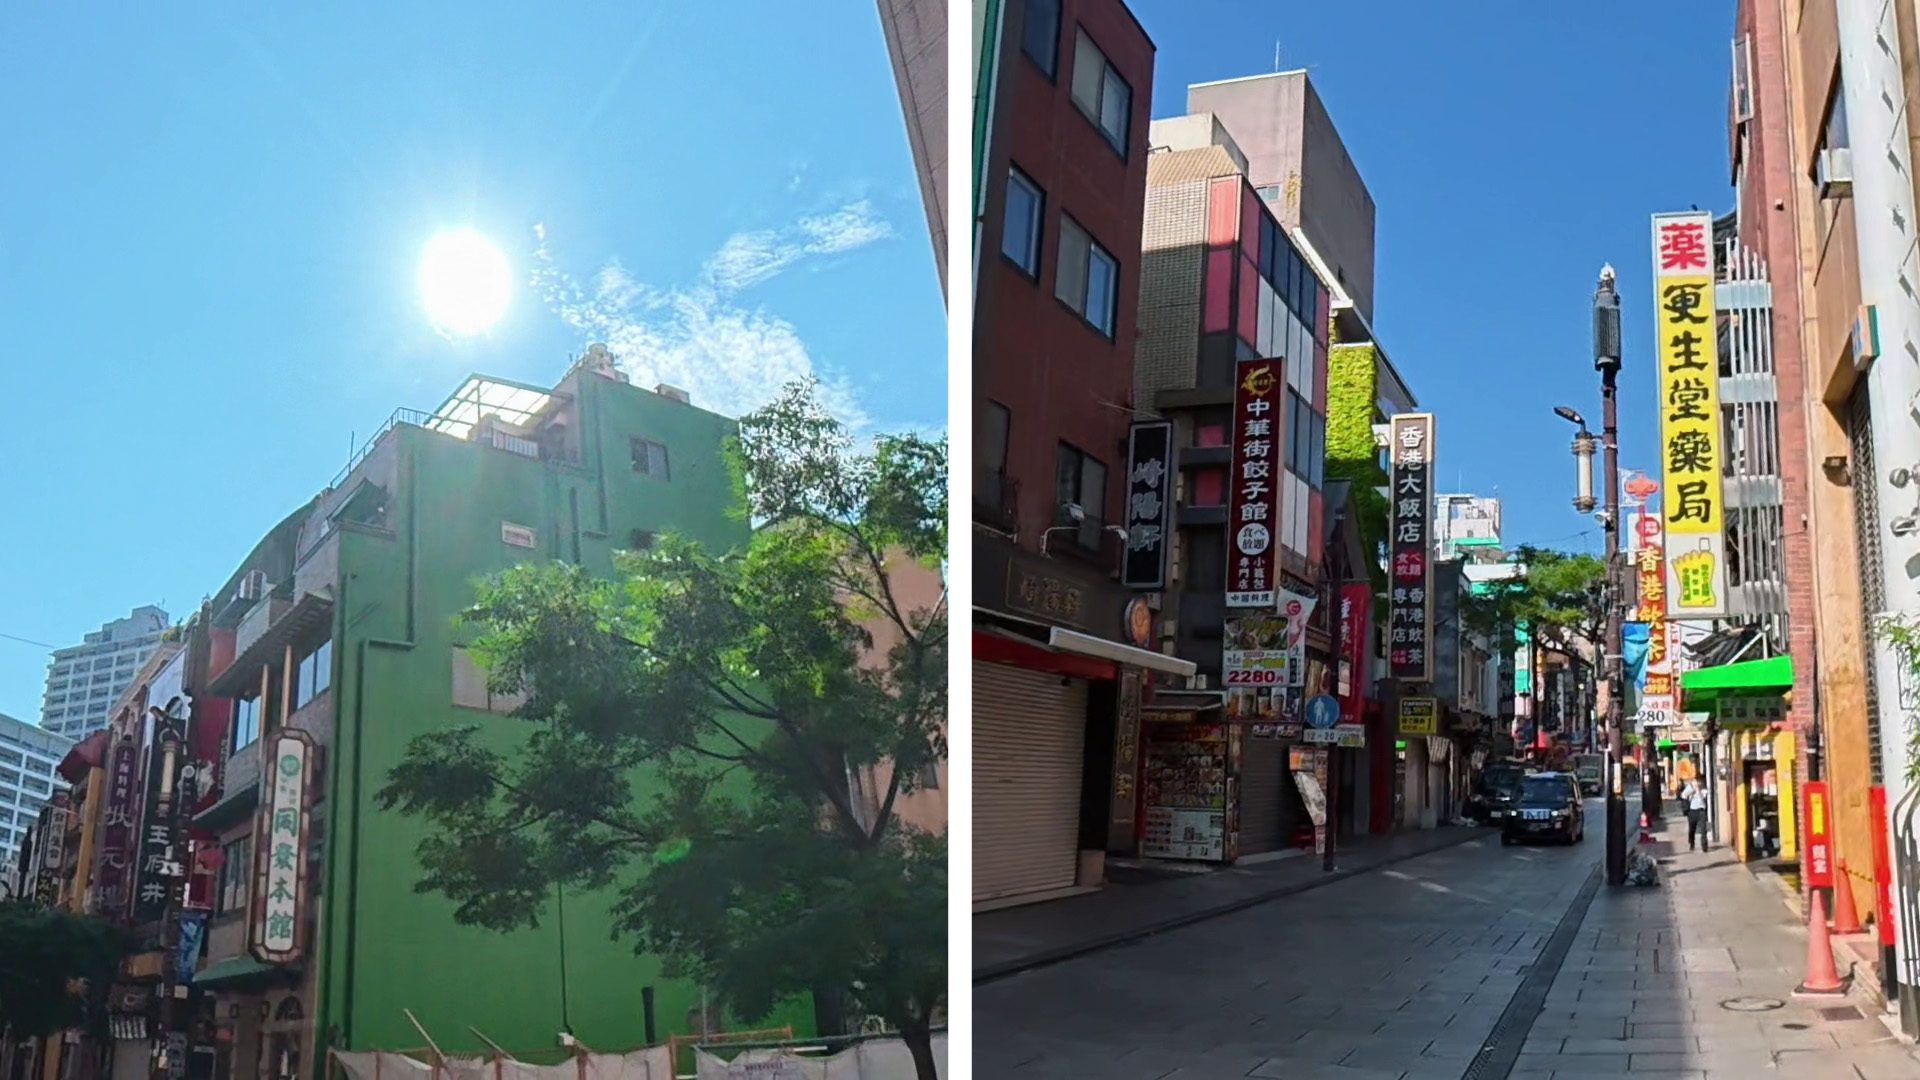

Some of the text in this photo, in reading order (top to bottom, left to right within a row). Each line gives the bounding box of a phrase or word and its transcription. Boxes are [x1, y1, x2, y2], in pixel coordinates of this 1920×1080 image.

[1660, 223, 1708, 270] 薬
[1240, 398, 1271, 521] 中華街餃子館
[1397, 426, 1424, 543] 香港大飯店
[1408, 587, 1424, 664] 香港飲茶
[141, 825, 170, 903] 王府井
